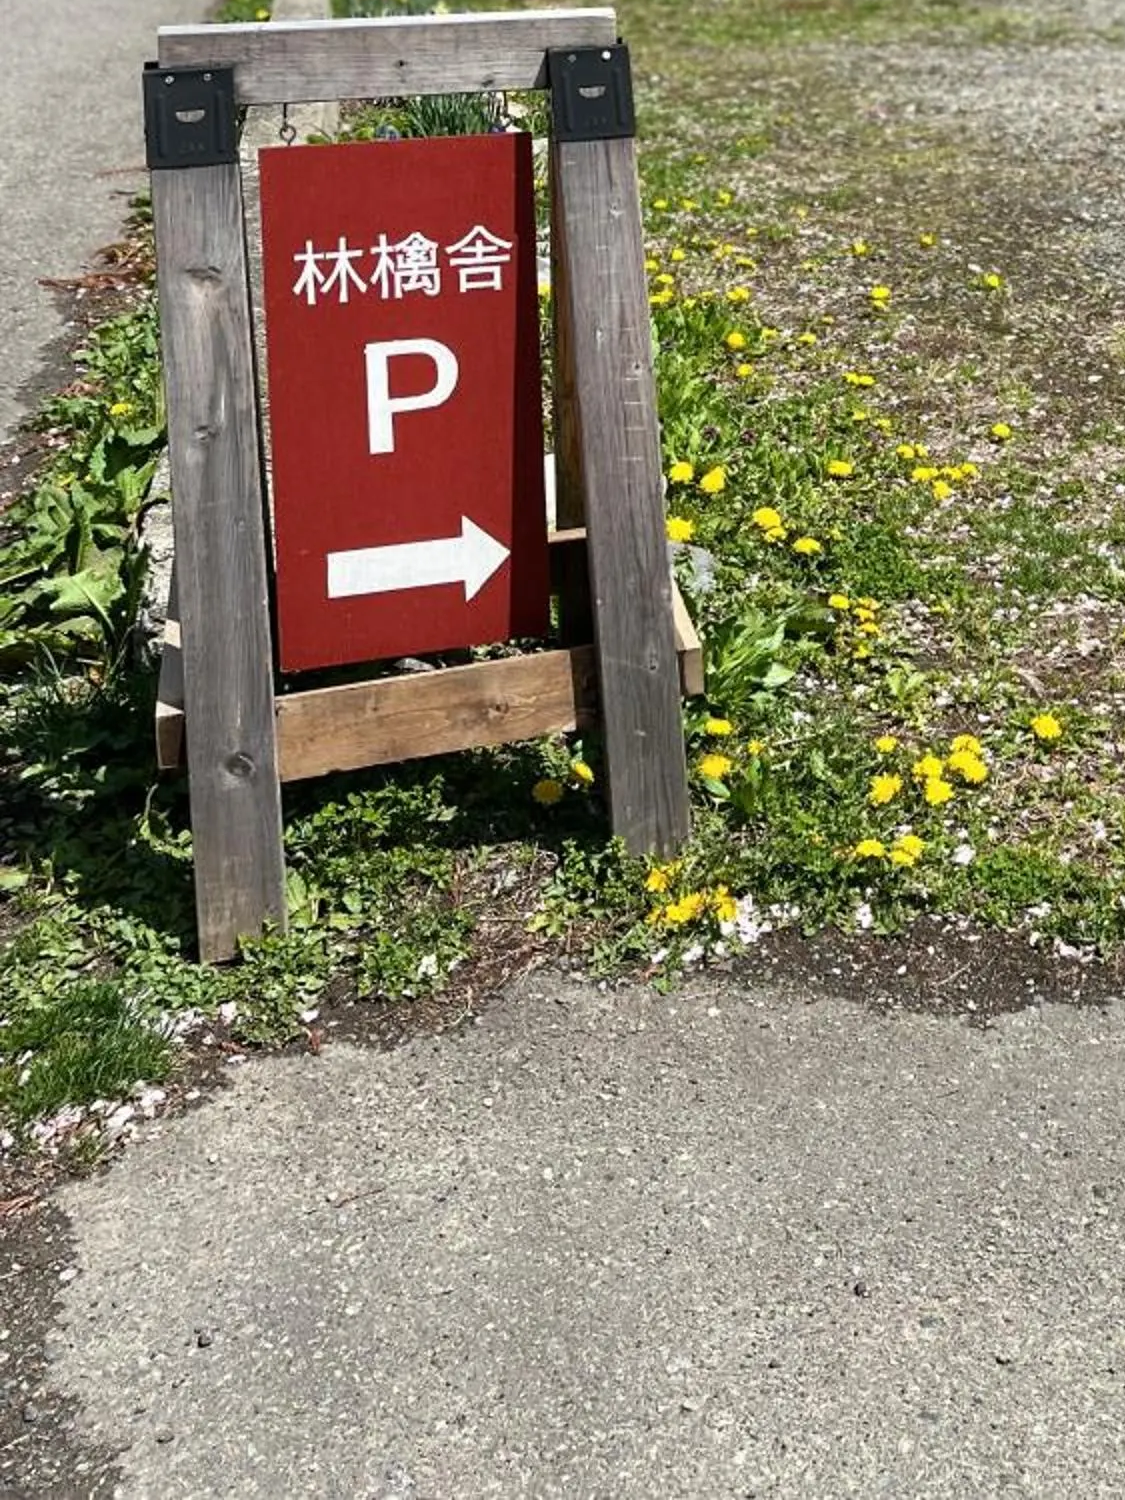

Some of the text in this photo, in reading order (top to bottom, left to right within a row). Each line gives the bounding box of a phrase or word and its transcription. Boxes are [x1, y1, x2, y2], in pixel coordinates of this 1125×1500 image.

[292, 225, 513, 305] 林檎舎
[364, 337, 459, 455] P
